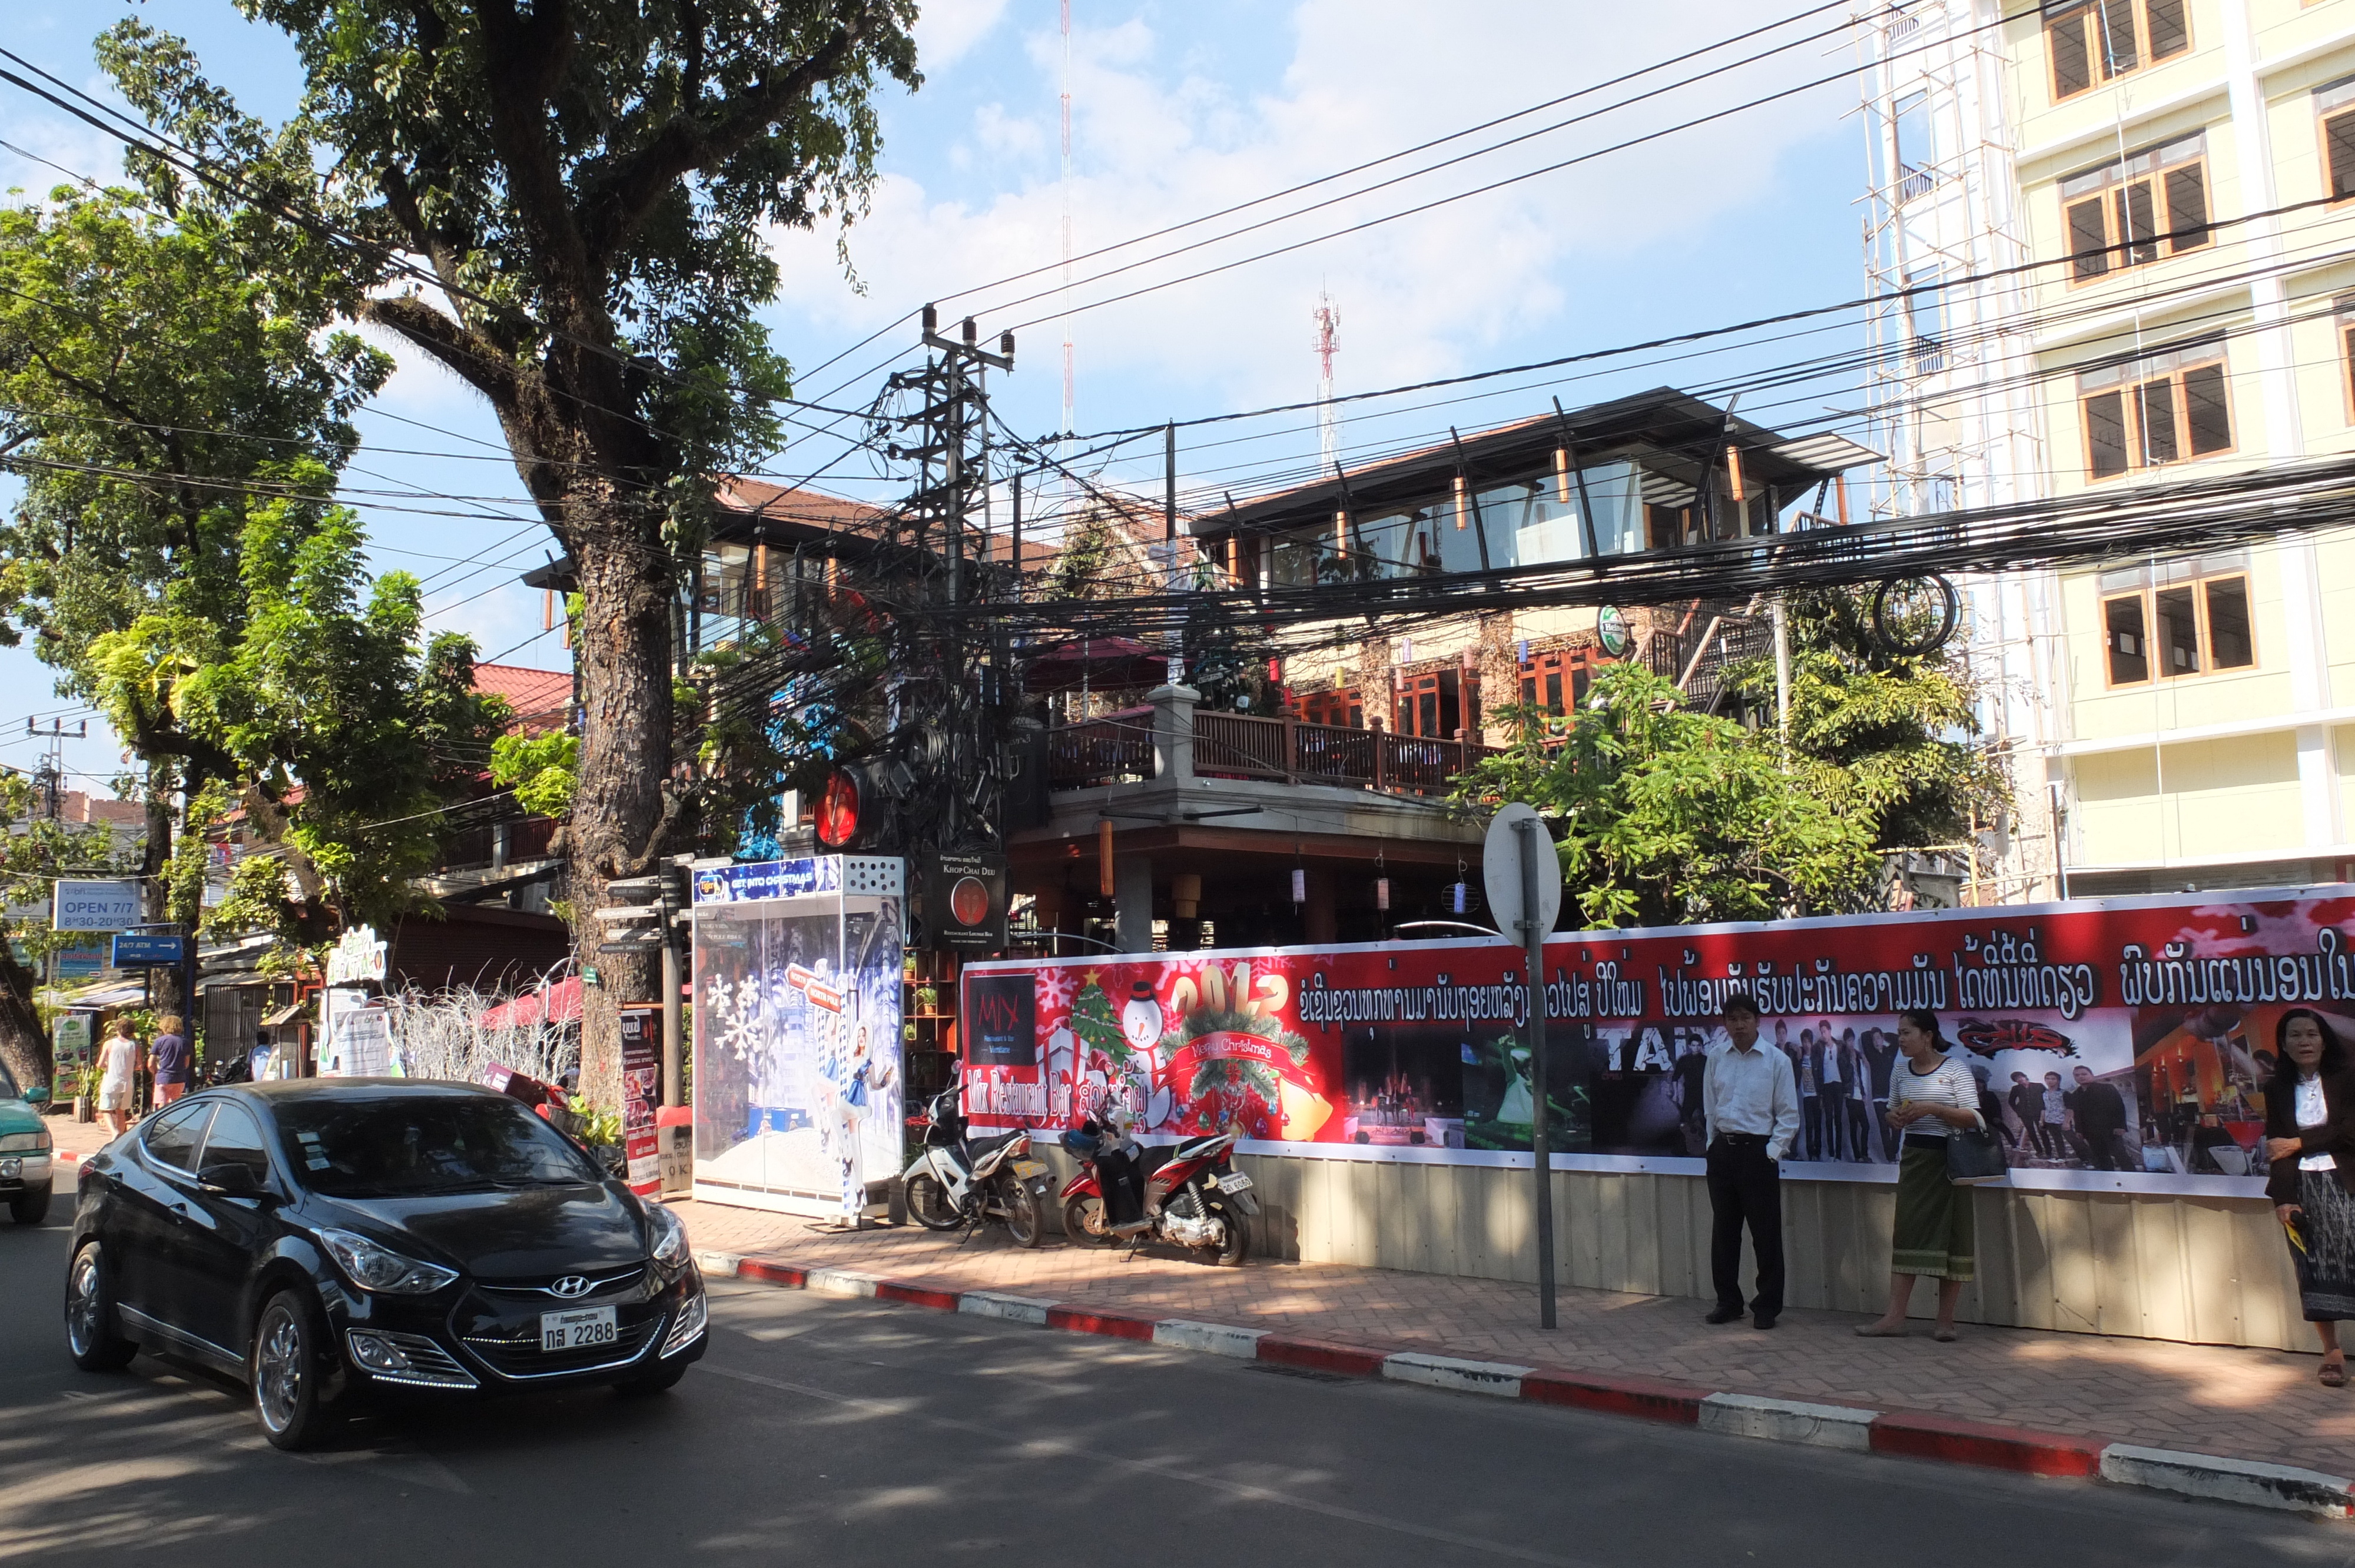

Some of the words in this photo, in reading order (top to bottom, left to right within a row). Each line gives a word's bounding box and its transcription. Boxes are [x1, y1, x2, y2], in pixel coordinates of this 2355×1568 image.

[944, 865, 963, 874] KHOP
[963, 866, 980, 875] CHAI
[732, 879, 746, 889] GET
[747, 877, 764, 887] INTO
[766, 872, 813, 885] CHRISTMAS
[65, 902, 108, 913] OPEN
[113, 902, 134, 913] 7/7
[1192, 1042, 1219, 1058] Merry
[1221, 1038, 1272, 1059] Christmas
[967, 1069, 989, 1114] Mix
[990, 1071, 1048, 1117] Restaurant
[1050, 1071, 1073, 1118] Bar
[574, 1321, 613, 1345] 2288
